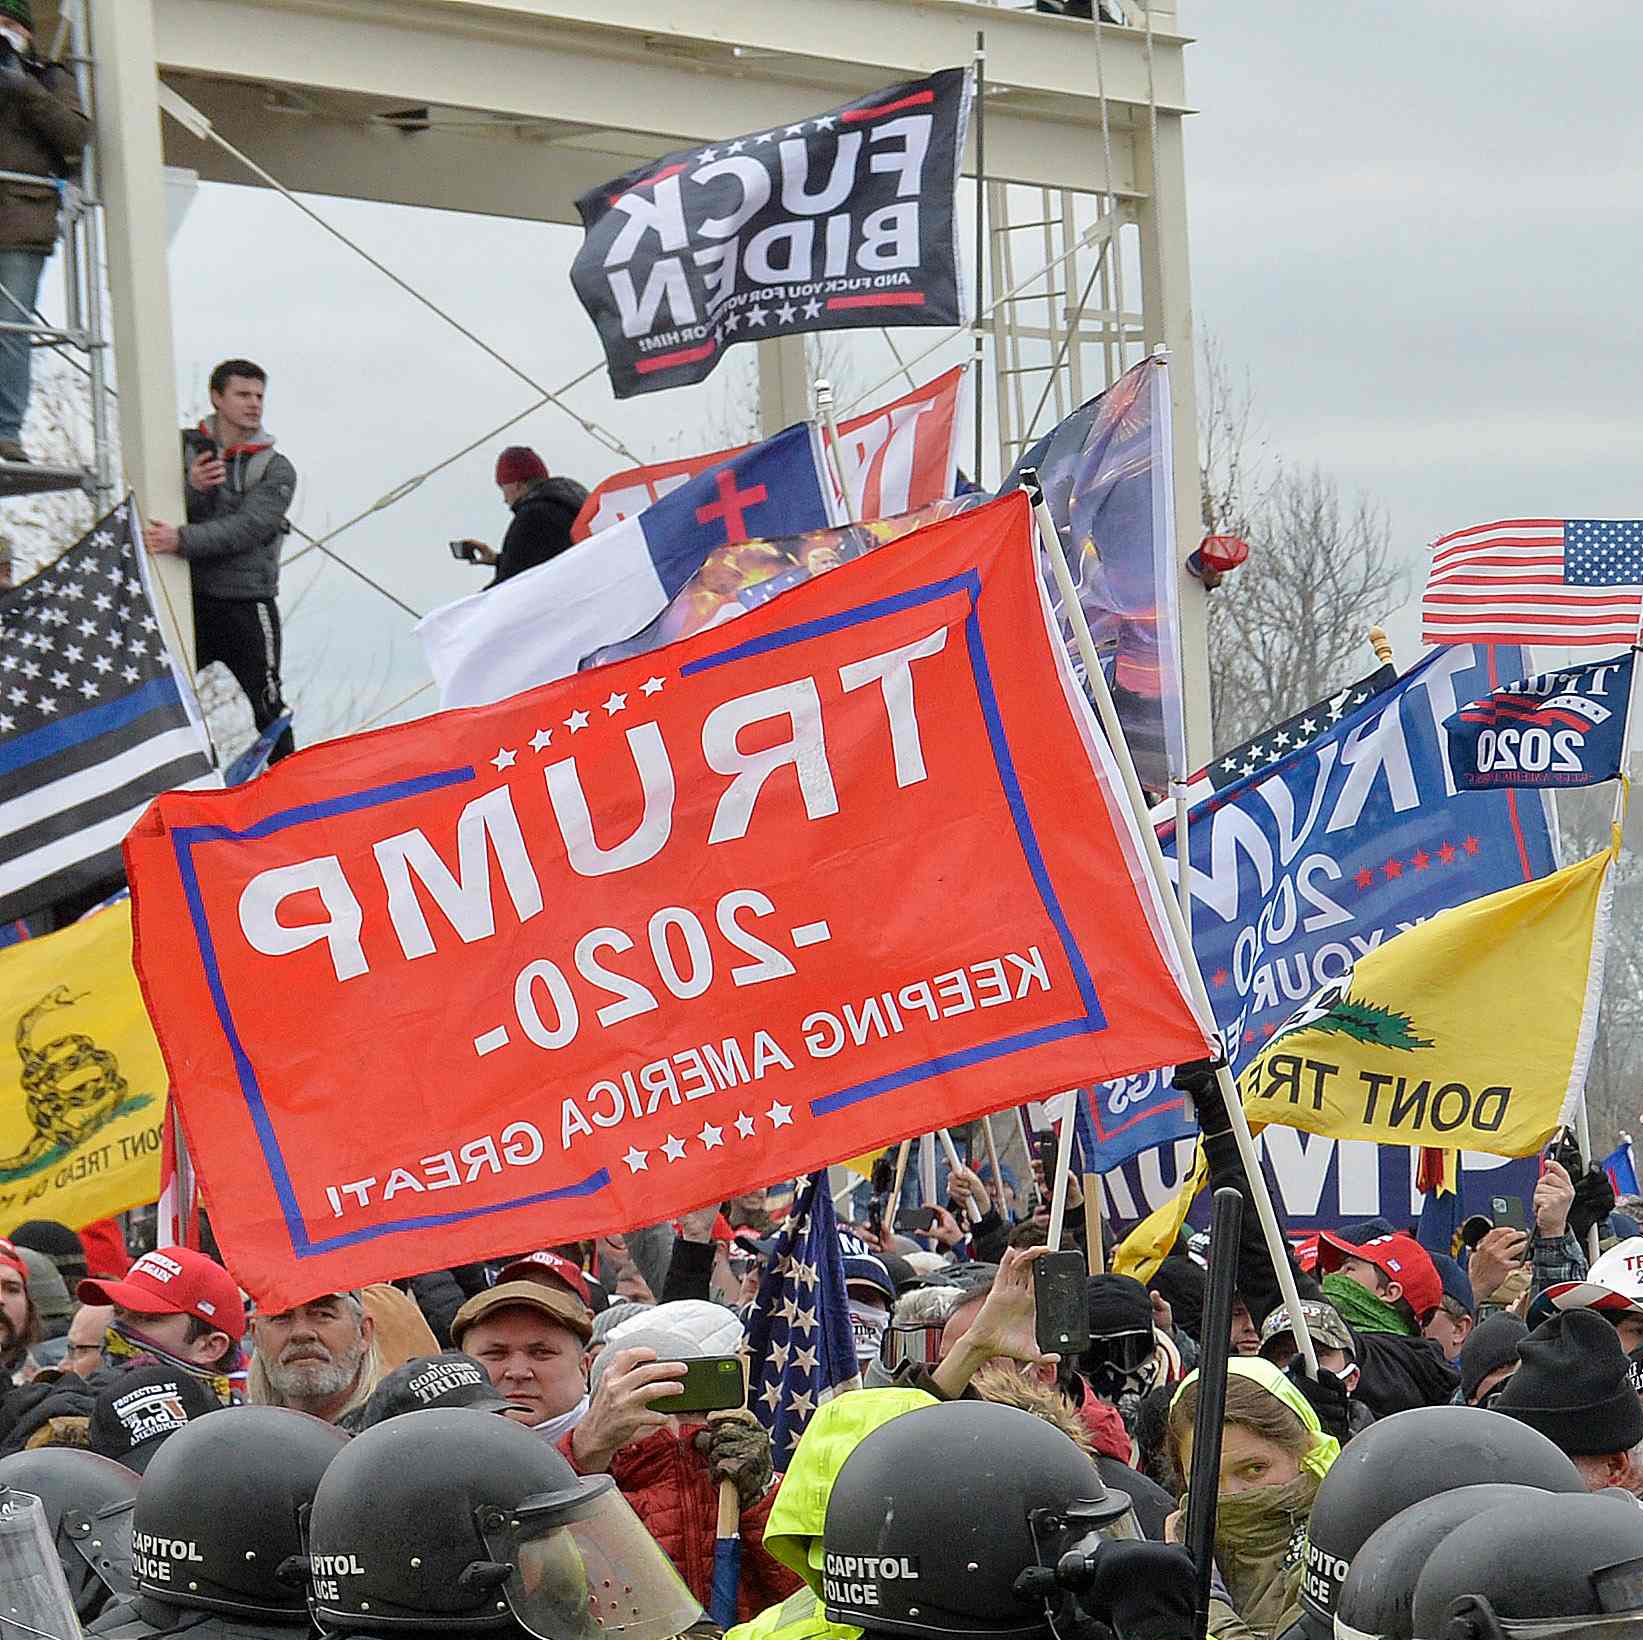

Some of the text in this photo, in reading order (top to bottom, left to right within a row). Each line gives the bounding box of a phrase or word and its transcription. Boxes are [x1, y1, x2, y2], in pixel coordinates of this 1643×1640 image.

[409, 1369, 438, 1392] GOD
[414, 1370, 483, 1405] TRUMP
[112, 1382, 179, 1410] PROTECTED BY
[130, 1407, 172, 1435] 2nd
[826, 1552, 919, 1580] CAPITOL
